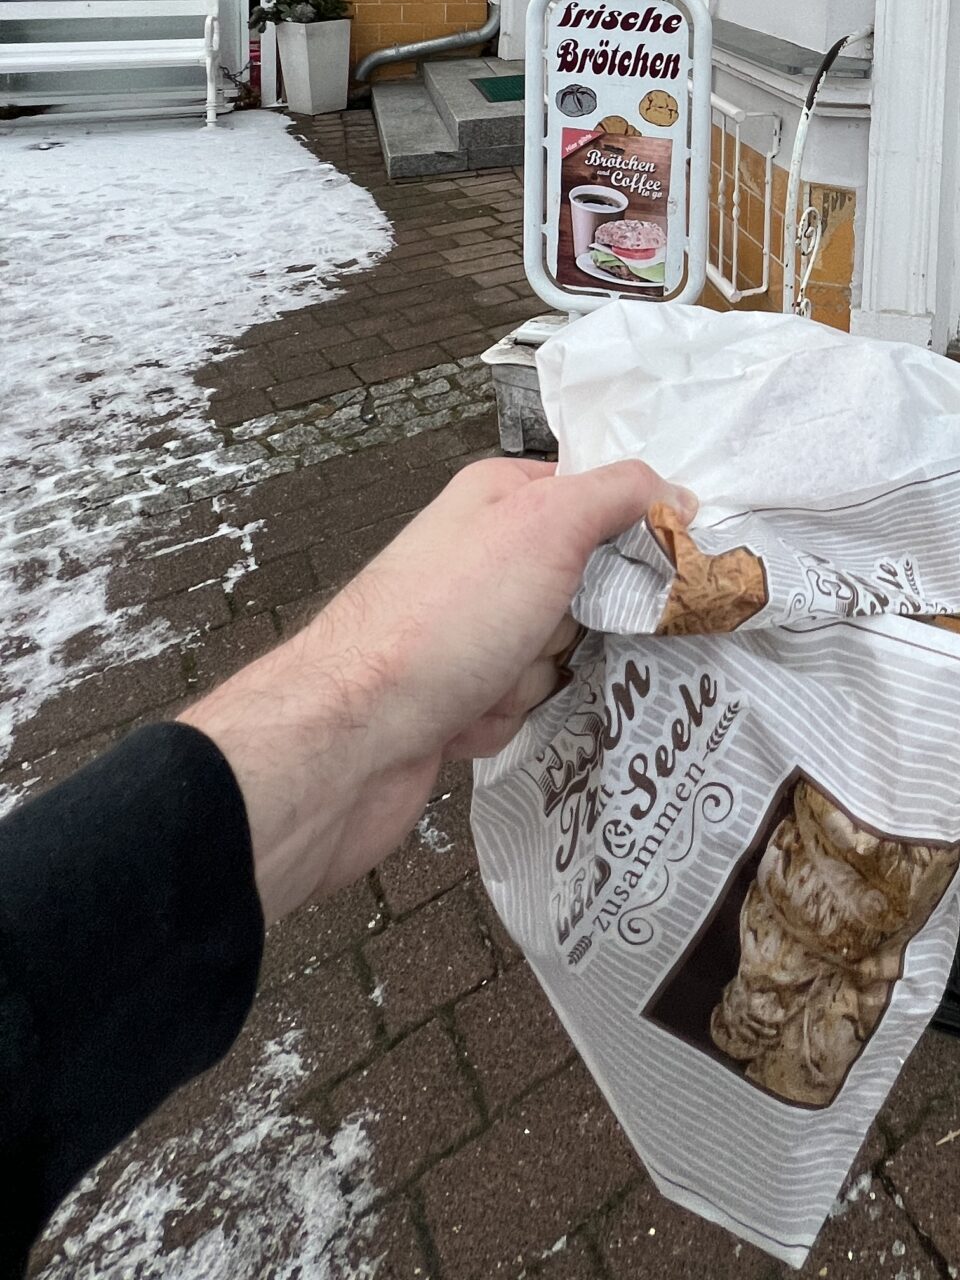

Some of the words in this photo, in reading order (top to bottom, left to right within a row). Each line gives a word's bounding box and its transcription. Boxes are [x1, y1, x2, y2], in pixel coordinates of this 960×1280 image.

[556, 1, 682, 35] frische
[556, 38, 681, 81] Brötchen
[584, 149, 656, 173] Brötchen
[610, 170, 662, 194] Coffee
[641, 189, 650, 197] to
[651, 191, 663, 200] go
[603, 819, 637, 859] &
[620, 672, 718, 821] Seele
[591, 762, 706, 934] zusammen
